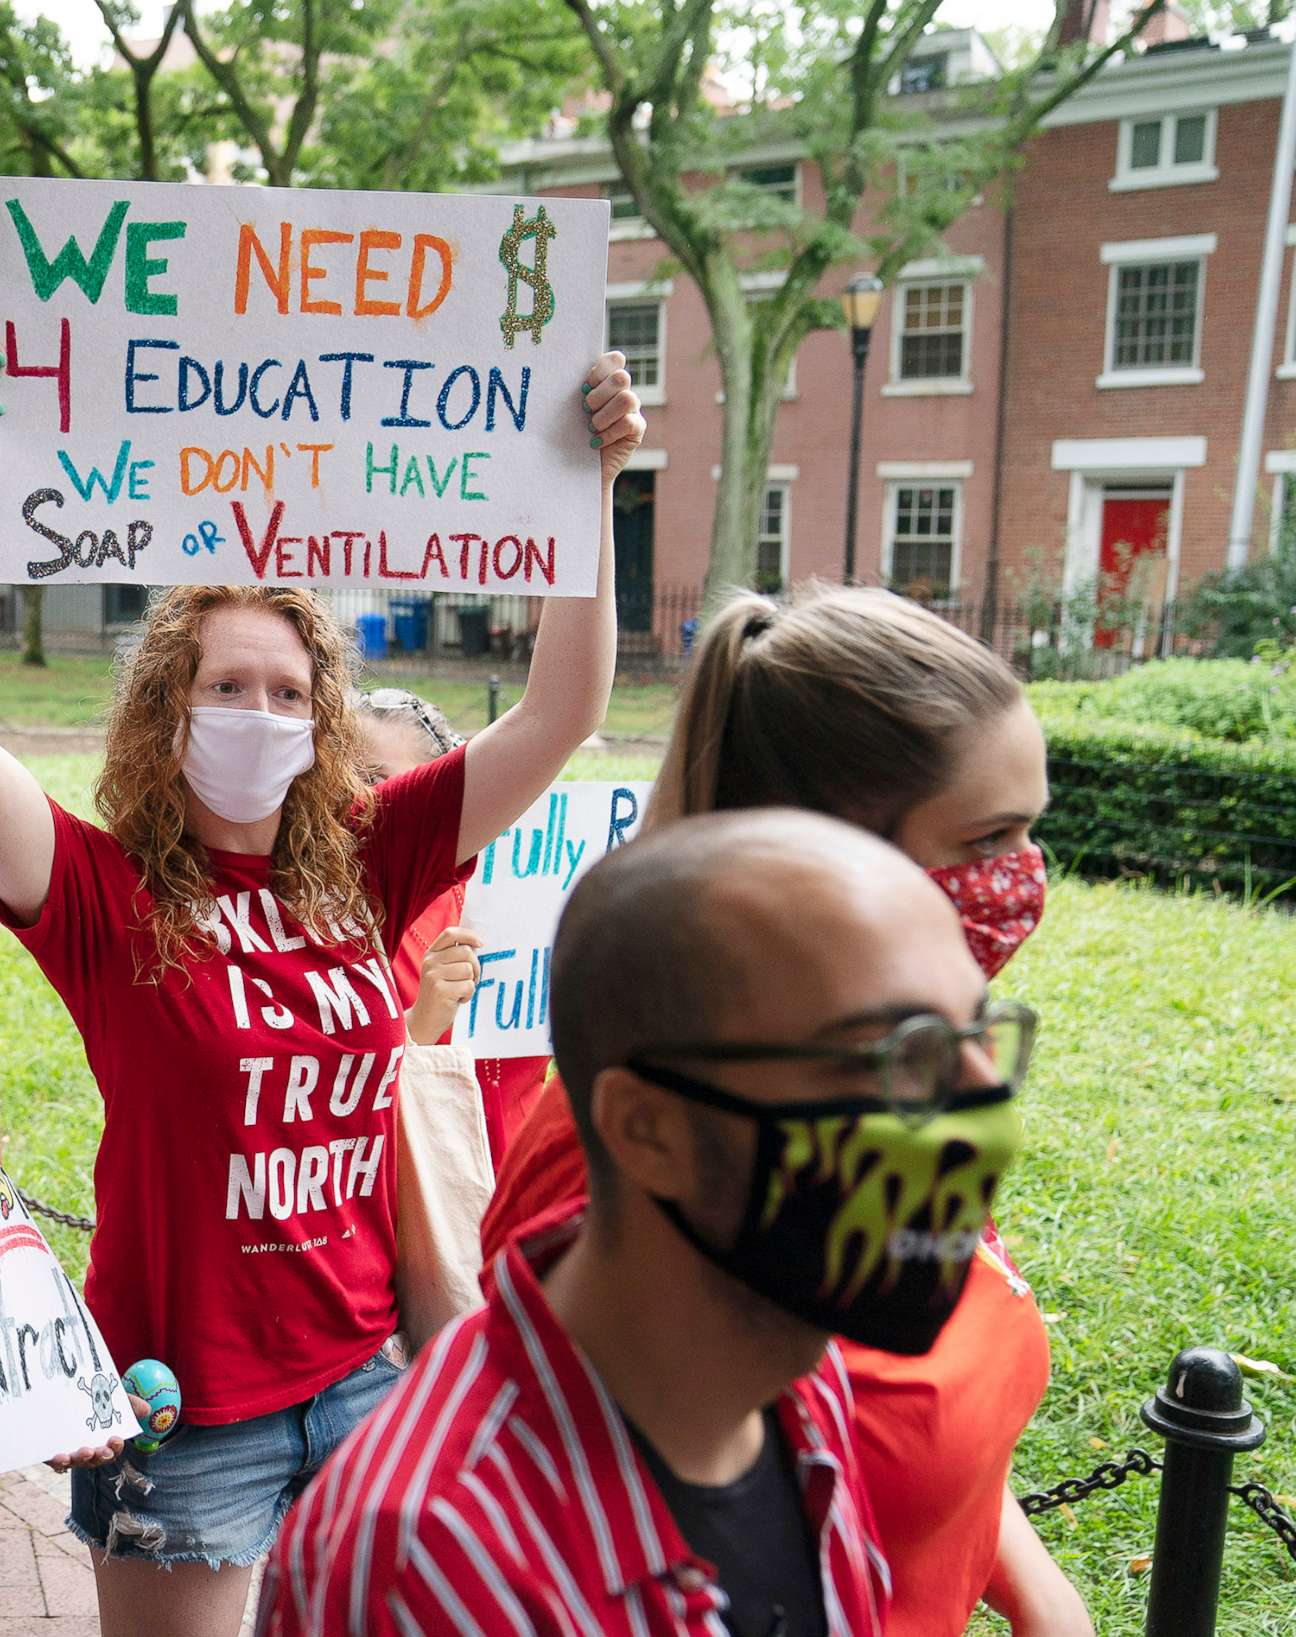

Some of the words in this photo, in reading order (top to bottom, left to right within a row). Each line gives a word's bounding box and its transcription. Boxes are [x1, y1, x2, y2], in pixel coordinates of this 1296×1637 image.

[5, 199, 187, 317] WE
[234, 220, 454, 320] NEED
[499, 203, 557, 350] $
[4, 316, 71, 434] 4
[125, 338, 532, 433] EDUCATION
[57, 439, 156, 504] WE
[179, 441, 336, 497] DON'T
[365, 441, 492, 501] HAVE
[22, 487, 154, 580] SOAP
[229, 500, 557, 586] VENTILATION
[226, 964, 295, 1030] IS
[303, 957, 399, 1036] MY
[468, 947, 552, 1039] Full
[239, 1045, 404, 1127] TRUE
[225, 1133, 384, 1221] NORTH
